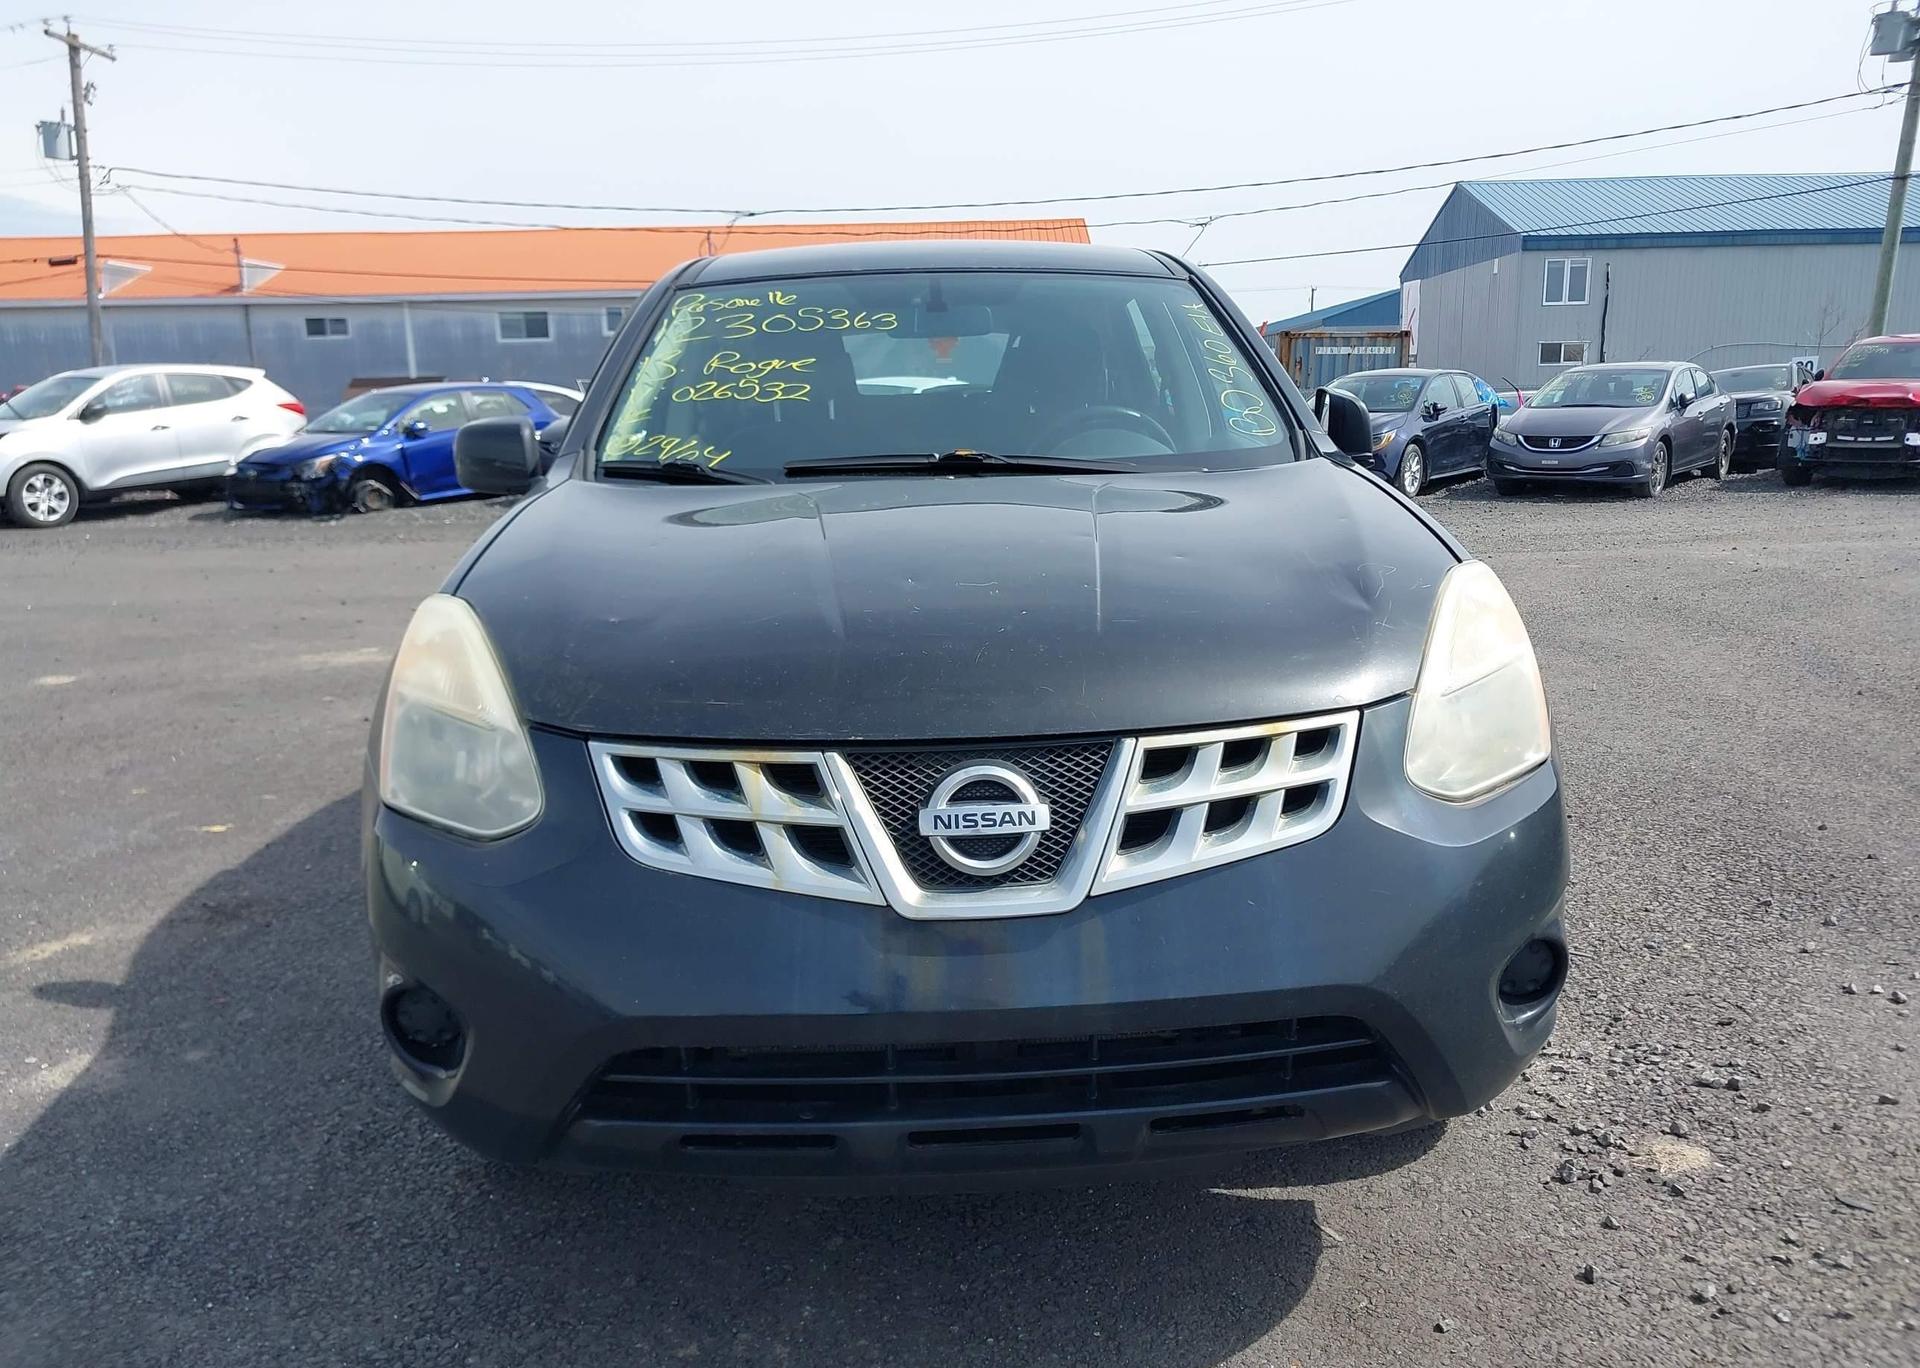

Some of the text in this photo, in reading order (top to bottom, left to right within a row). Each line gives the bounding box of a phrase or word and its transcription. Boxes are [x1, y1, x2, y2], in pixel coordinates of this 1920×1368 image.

[703, 351, 816, 379] Rogue
[672, 378, 811, 402] 026532
[933, 810, 1036, 831] NISSAN
